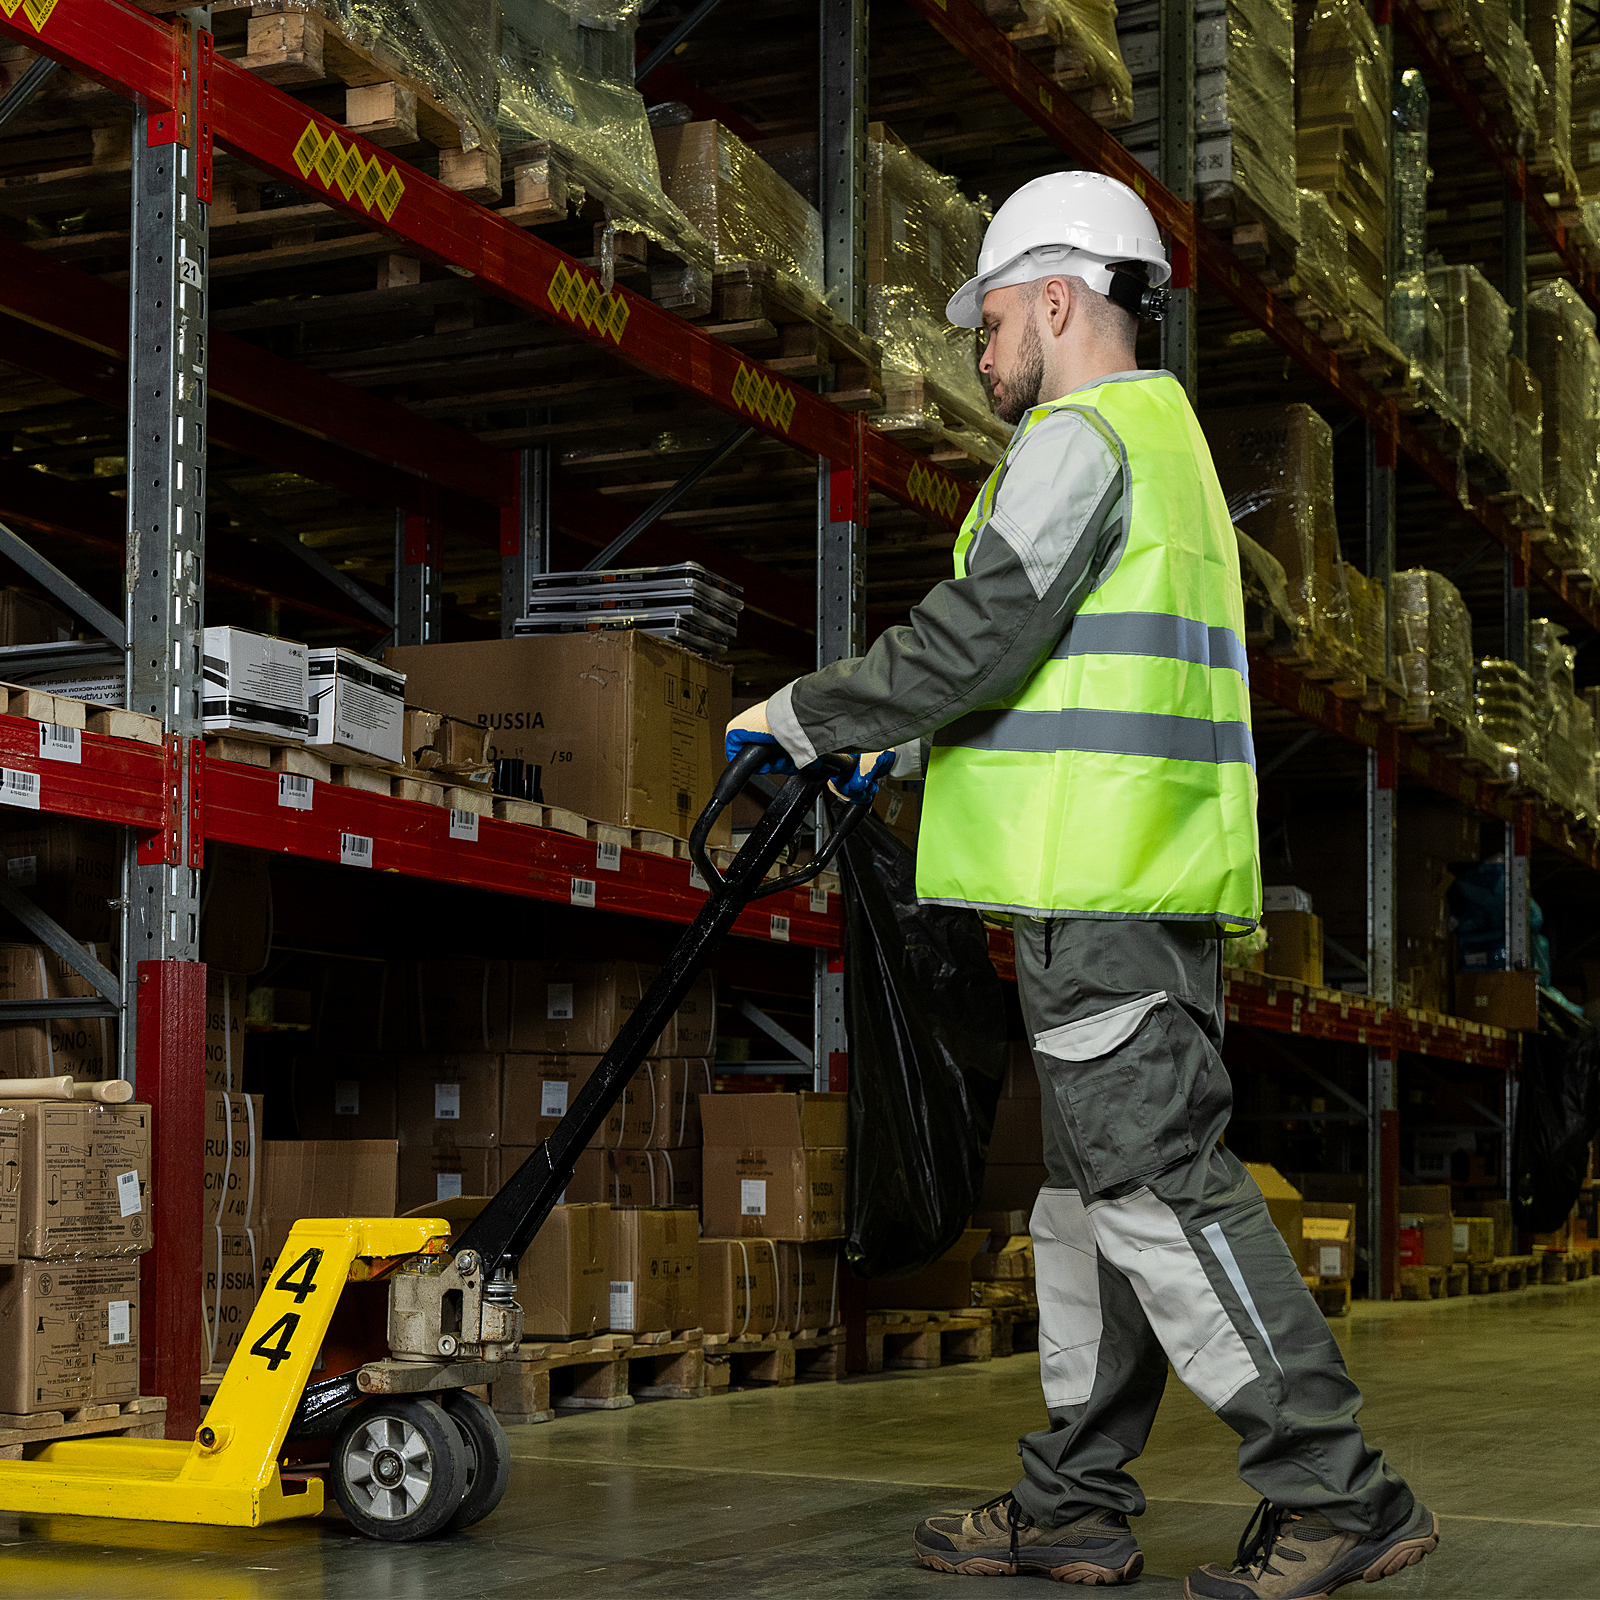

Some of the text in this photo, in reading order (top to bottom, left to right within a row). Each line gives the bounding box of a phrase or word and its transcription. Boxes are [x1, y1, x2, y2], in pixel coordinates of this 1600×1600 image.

[183, 261, 196, 281] 21
[478, 712, 545, 730] RUSSIA
[51, 1030, 91, 1054] C/NO:
[275, 1247, 325, 1304] 4
[250, 1313, 301, 1371] 4
